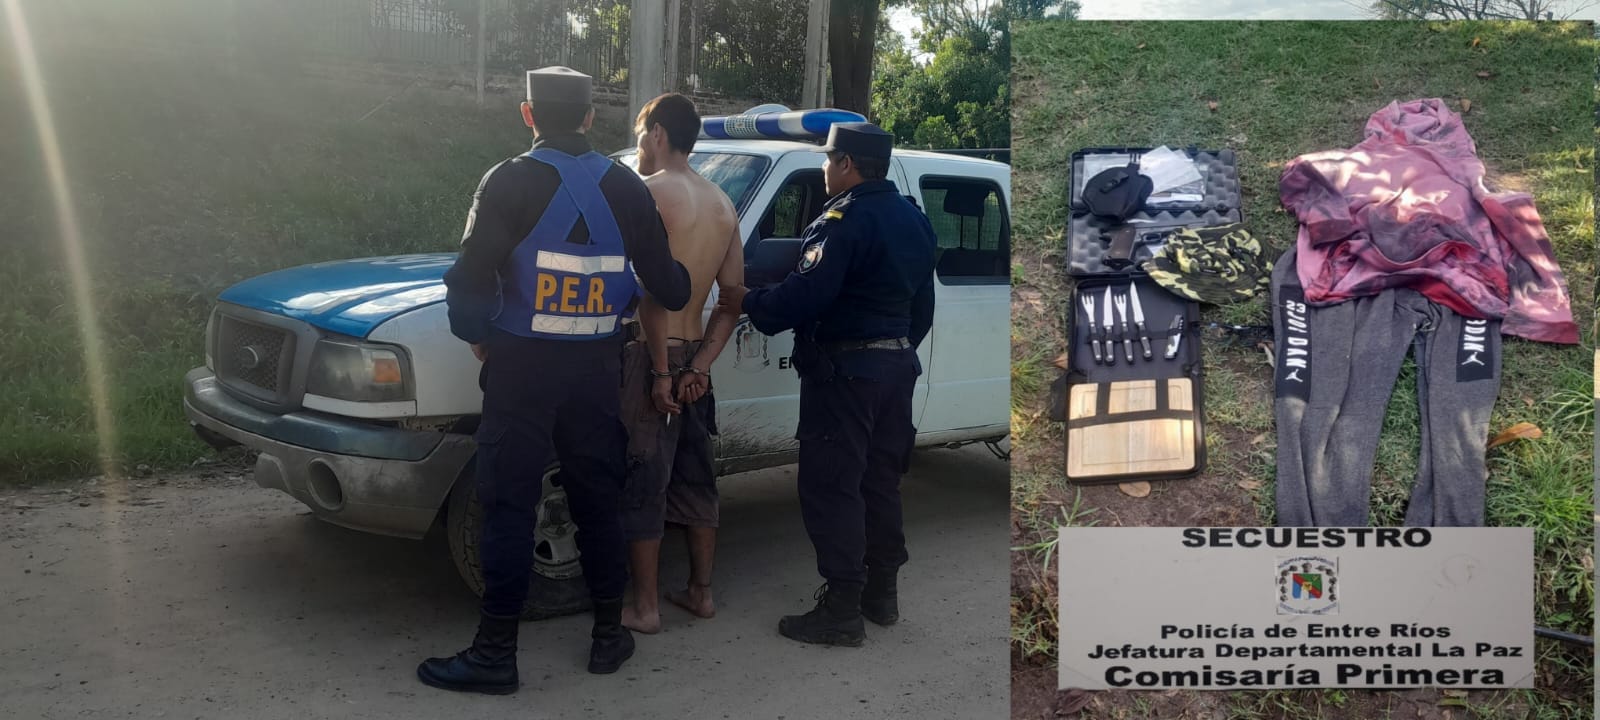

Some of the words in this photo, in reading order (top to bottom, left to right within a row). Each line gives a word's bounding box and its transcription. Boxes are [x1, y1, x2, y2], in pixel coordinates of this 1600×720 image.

[535, 272, 614, 314] P.E.R.
[1286, 311, 1309, 369] JODAN
[1182, 527, 1432, 549] SECUESTRO
[1161, 623, 1255, 640] Policía
[1264, 623, 1298, 639] de
[1307, 623, 1381, 639] Entre
[1390, 622, 1451, 639] Ríos
[1087, 644, 1205, 660] Jefatura
[1215, 643, 1422, 662] Departamental
[1432, 643, 1465, 659] La
[1475, 643, 1524, 659] Paz
[1104, 663, 1321, 688] Comisaría
[1336, 663, 1505, 688] Primera
